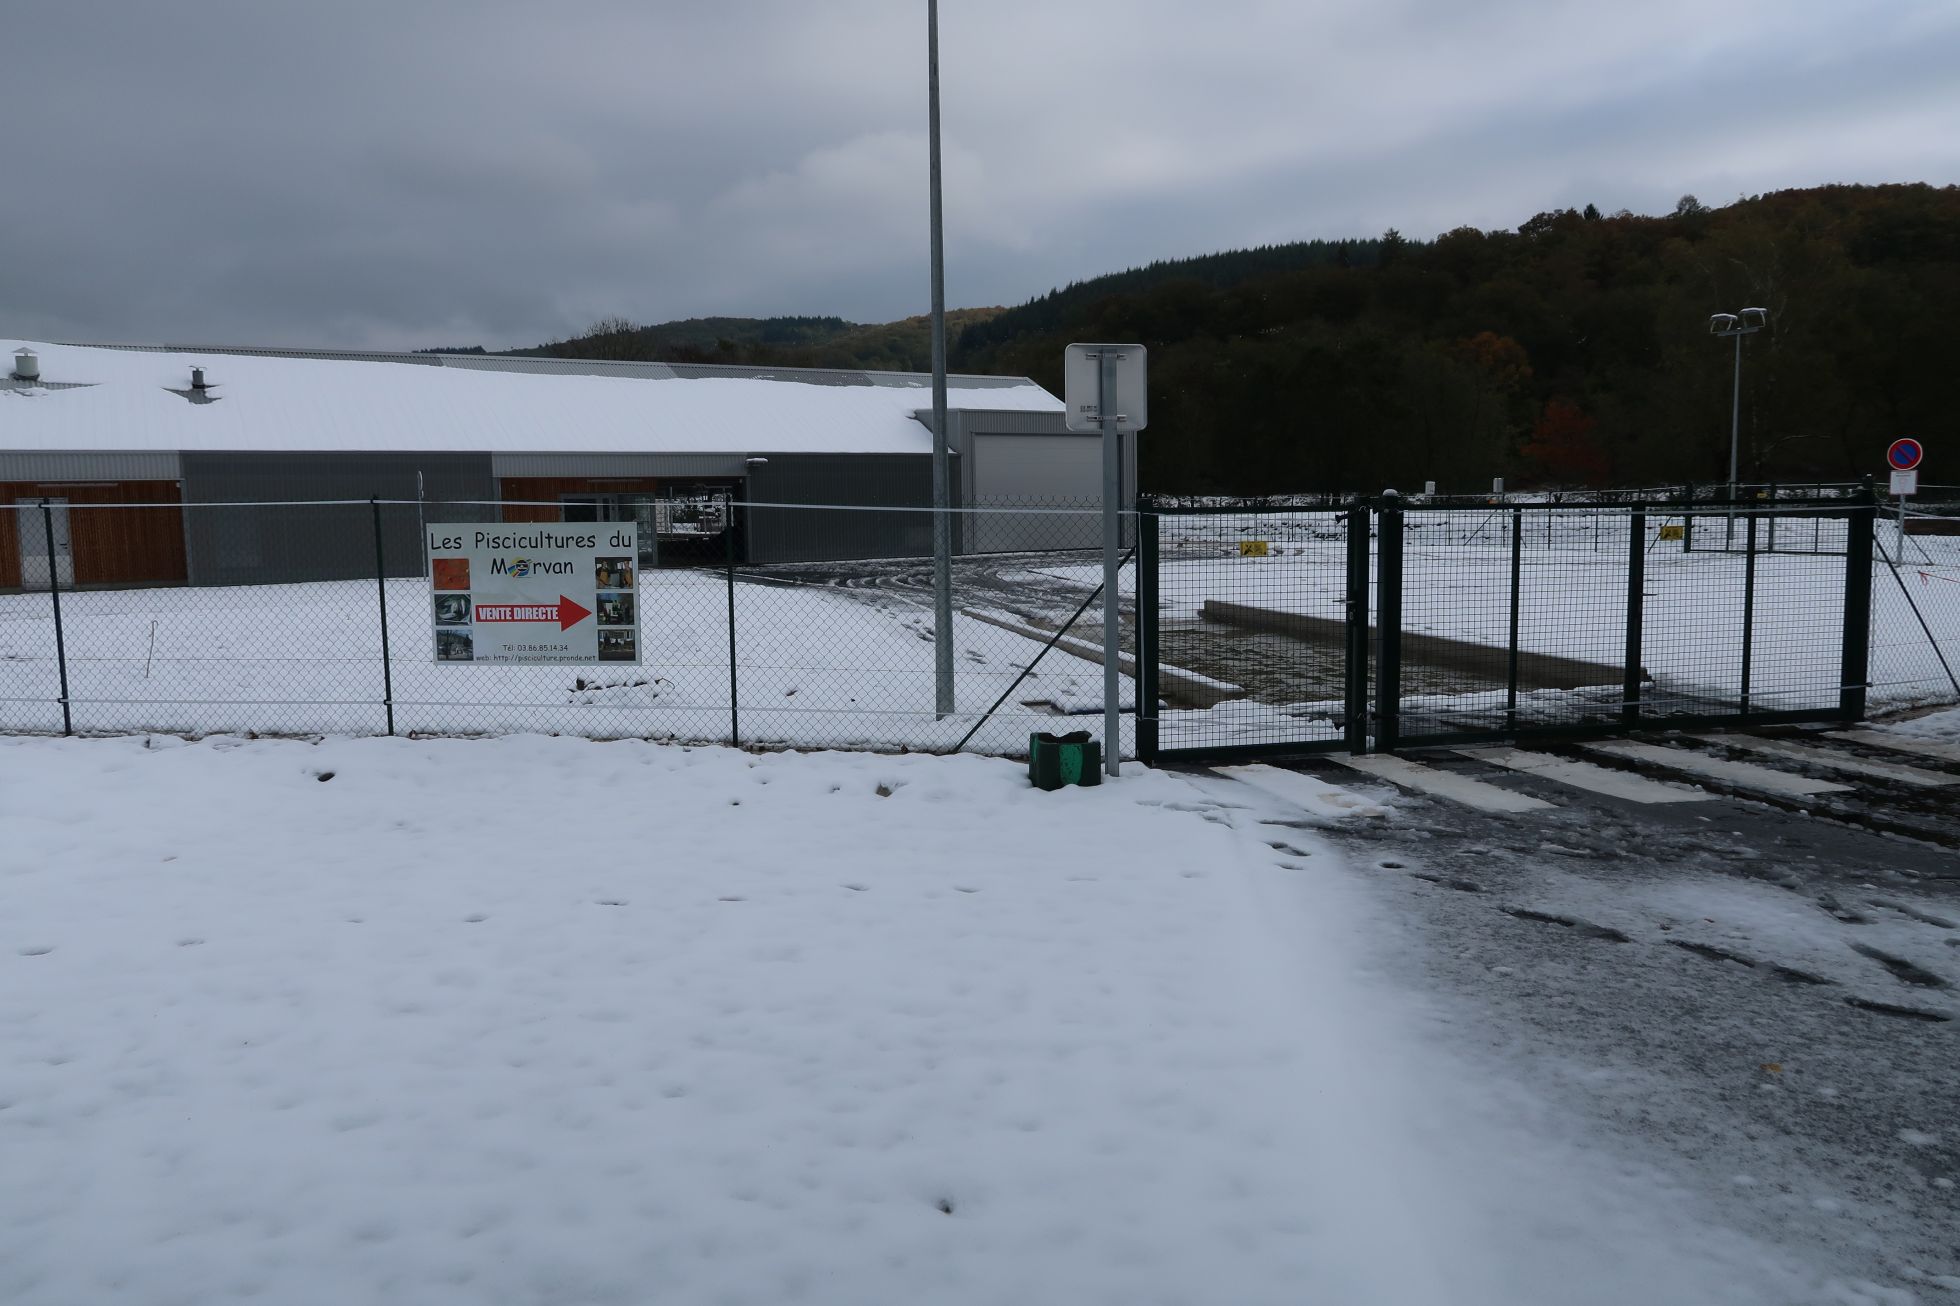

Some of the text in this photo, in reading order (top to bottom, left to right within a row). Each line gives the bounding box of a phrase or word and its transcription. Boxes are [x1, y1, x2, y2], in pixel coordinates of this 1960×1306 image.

[431, 530, 632, 550] Les Piscicultures du
[478, 607, 559, 620] VENTE DIRECTE
